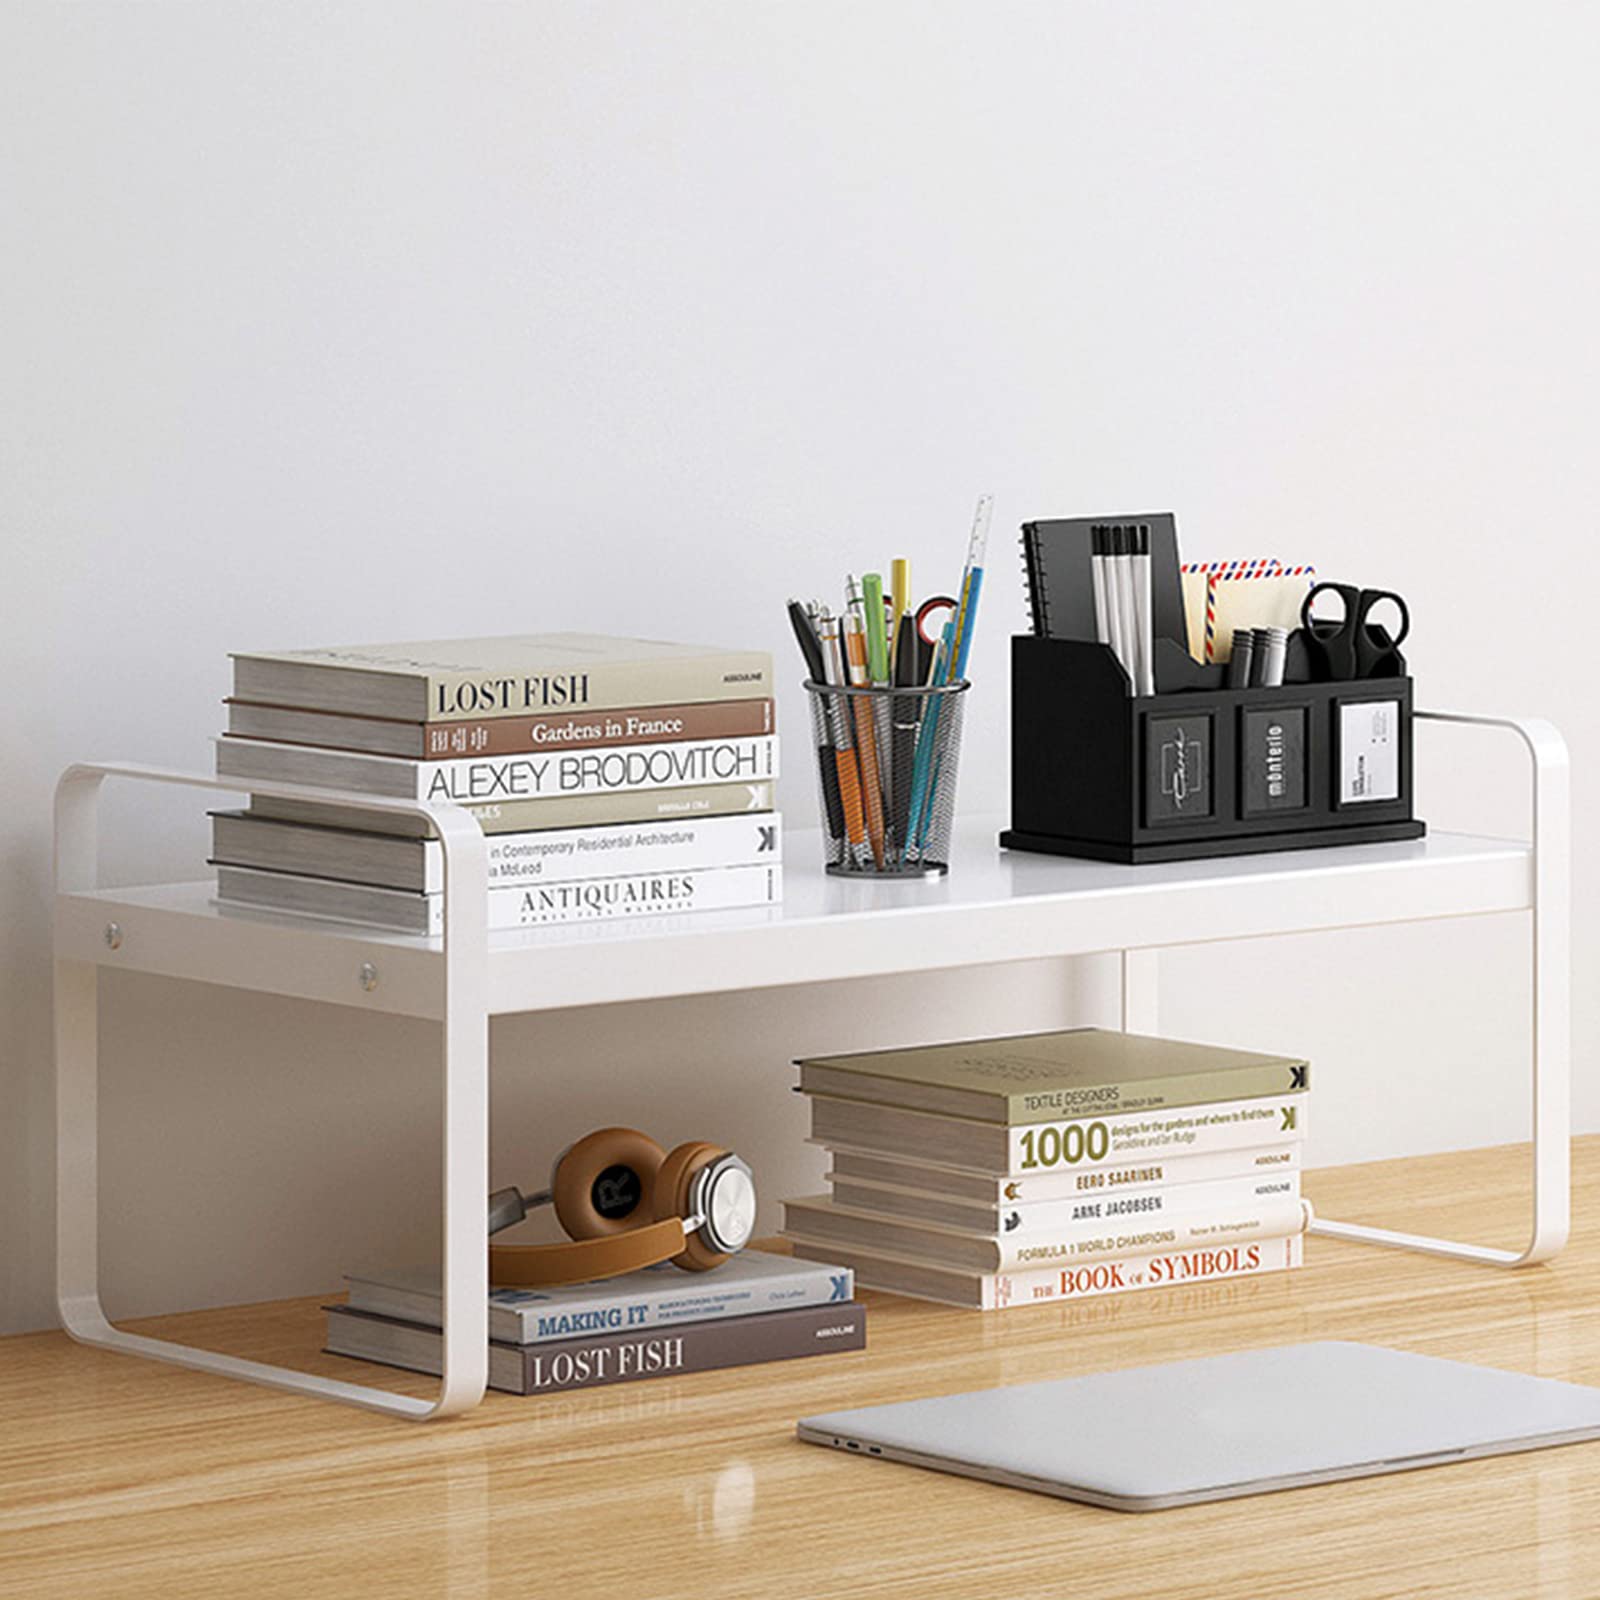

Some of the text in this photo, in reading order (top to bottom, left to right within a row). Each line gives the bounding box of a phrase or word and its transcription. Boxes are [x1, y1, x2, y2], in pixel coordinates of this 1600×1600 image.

[438, 674, 589, 713] LOST FISH
[532, 716, 683, 744] Gardens in France
[428, 760, 549, 800] ALEXEY
[560, 744, 757, 790] BRODOVITCH
[503, 841, 575, 859] Contemporary
[577, 834, 633, 852] Residential
[635, 831, 695, 847] Architecture
[500, 861, 542, 876] McLeod
[521, 876, 694, 912] ANTIQUAIRES
[1024, 1086, 1120, 1111] TEXTILE DESIGNERS
[1111, 1125, 1139, 1137] designs
[1140, 1122, 1151, 1133] for
[1152, 1121, 1163, 1131] the
[1195, 1115, 1209, 1126] and
[1020, 1121, 1109, 1169] 1000
[1077, 1167, 1163, 1190] EERO SAARINEN
[1072, 1197, 1162, 1220] ARNE JACOBSEN
[1017, 1230, 1176, 1261] FORMULA 1 WORLD CHAMPIONS
[1032, 1285, 1053, 1299] THE
[1060, 1263, 1125, 1295] BOOK
[1148, 1245, 1260, 1283] SYMBOLS
[538, 1304, 649, 1337] MAKING IT
[533, 1338, 684, 1388] LOST FISH
